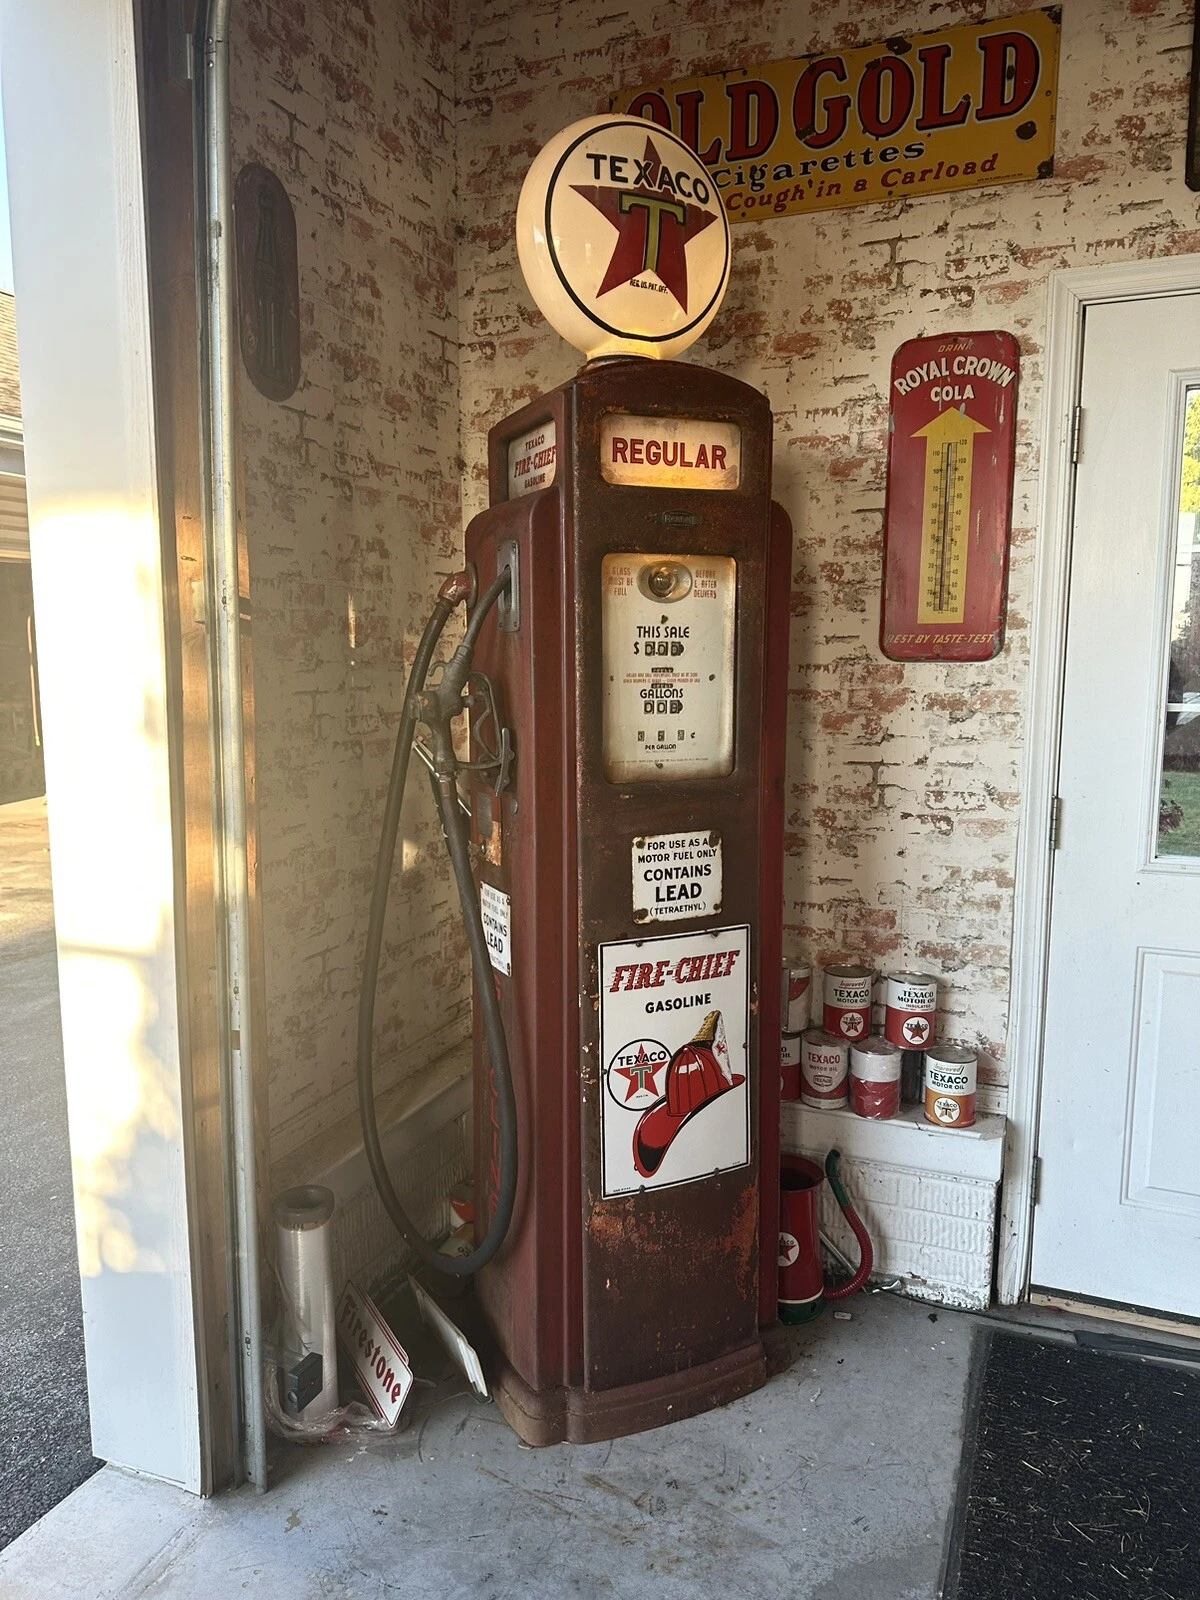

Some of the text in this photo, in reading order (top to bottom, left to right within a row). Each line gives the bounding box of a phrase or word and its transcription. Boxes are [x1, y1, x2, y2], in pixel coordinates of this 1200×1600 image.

[627, 31, 1041, 166] OLD GOLD
[712, 142, 925, 192] Cigarettes
[853, 178, 868, 192] a
[881, 153, 999, 188] Carload
[586, 153, 710, 204] TEXACO
[619, 191, 687, 274] T
[938, 339, 974, 352] DRINK
[894, 356, 1016, 396] ROYAL CROWN
[930, 385, 974, 402] COLA
[525, 434, 545, 451] TEXACO
[612, 437, 727, 470] REGULAR
[514, 446, 556, 478] FIRE-CHIEF
[525, 473, 546, 489] GASOLINE
[627, 578, 633, 586] BE
[614, 588, 627, 596] FULL
[637, 626, 690, 638] THIS SALE
[915, 635, 931, 644] BY
[933, 634, 994, 644] TASTE-TEST
[634, 642, 640, 655] $
[640, 688, 684, 699] GALLONS
[647, 838, 708, 851] FOR USE AS A
[638, 849, 717, 863] MOTOR FUEL ONLY
[644, 864, 712, 882] CONTAINS
[656, 883, 702, 902] LEAD
[650, 902, 707, 916] (TETRAETHYL)
[483, 912, 507, 937] CONTAINS
[487, 930, 504, 954] LEAD
[608, 950, 740, 993] FIRE-CHIEF
[834, 989, 870, 998] TEXACO
[897, 996, 926, 1004] MOTOR
[903, 990, 934, 999] TEXACO
[646, 993, 712, 1014] GASOLINE
[618, 1051, 667, 1067] TEXACO
[808, 1052, 841, 1064] TEXACO
[630, 1065, 653, 1090] T
[930, 1071, 969, 1084] TEXACO
[932, 1081, 953, 1090] MOTOR
[340, 1293, 402, 1404] Firestone
